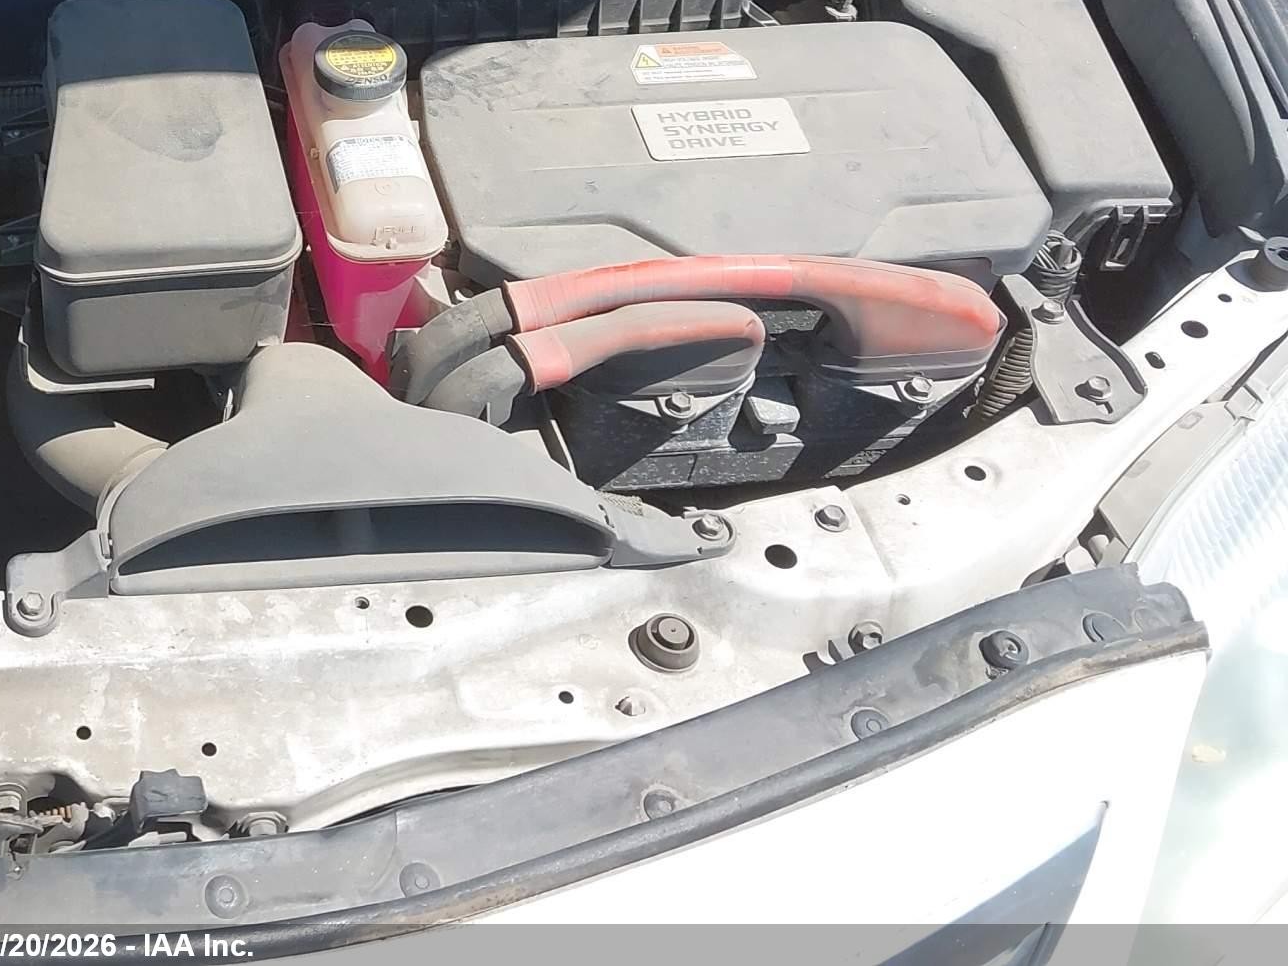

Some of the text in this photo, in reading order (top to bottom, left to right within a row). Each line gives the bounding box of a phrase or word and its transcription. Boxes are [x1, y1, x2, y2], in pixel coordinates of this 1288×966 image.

[344, 74, 389, 84] DENSO
[657, 107, 752, 123] HYBRID
[663, 120, 780, 136] SYNERGY
[668, 136, 745, 150] DRIVE
